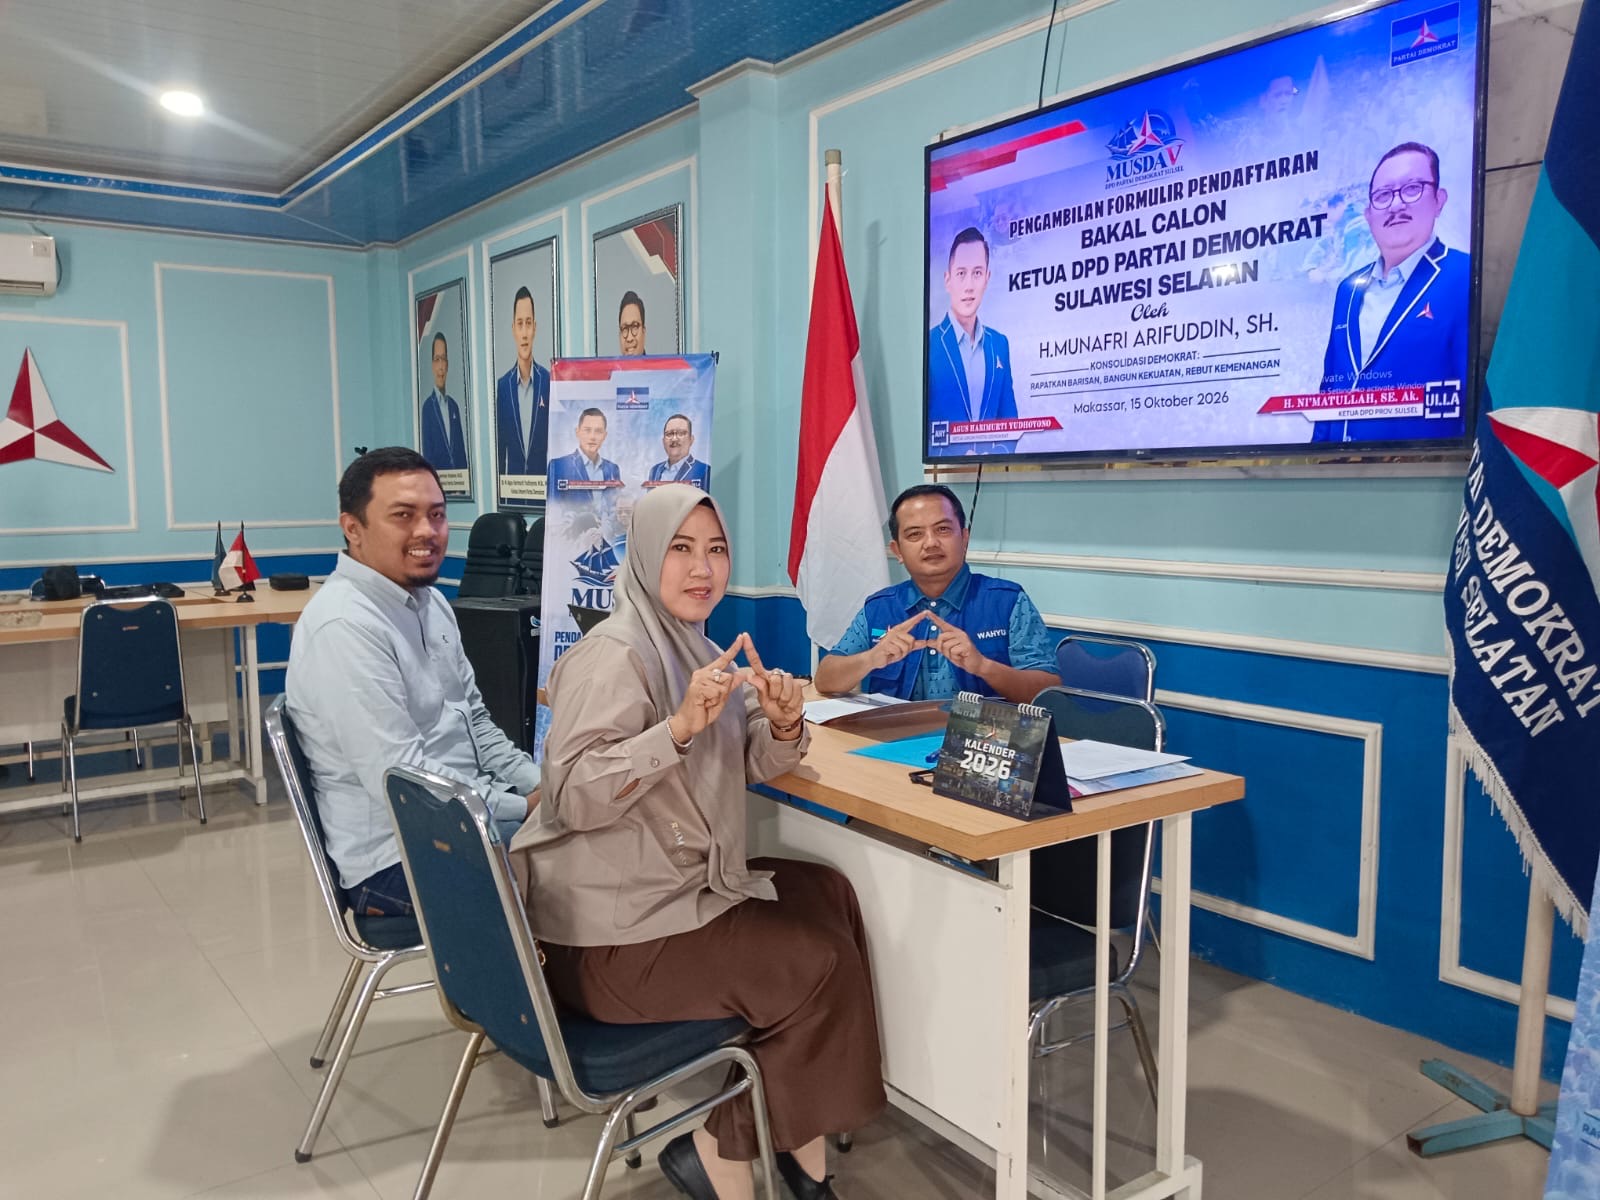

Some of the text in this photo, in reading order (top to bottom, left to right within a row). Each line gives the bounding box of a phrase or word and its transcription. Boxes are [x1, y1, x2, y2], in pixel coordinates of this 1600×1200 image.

[1393, 40, 1456, 63] PARTAI DEMOKRAT
[1106, 144, 1183, 182] MUSDA V
[1116, 178, 1134, 187] PARTAI
[1135, 170, 1164, 182] DEMOKRAT
[1009, 150, 1319, 238] PENGAMBILAN FORMULIR PENDAFTARAN
[1081, 200, 1226, 249] BAKAL CALON
[1009, 213, 1328, 292] KETUA DPD PARTAI DEMOKRAT
[1054, 260, 1258, 312] SULAWESI SELATAN
[1131, 302, 1169, 322] Oleh
[1039, 312, 1278, 359] H.MUNAFRI ARIFUDDIN, SH.
[1090, 351, 1200, 371] KONSOLIDASI DEMOKRAT:
[1030, 359, 1281, 391] RAPATKAN BARISAN, BANGUN KEKUATAN, REBUT KEMENANGAN
[1073, 391, 1229, 414] Makassar, 15 Oktober 2026
[1283, 398, 1295, 409] H.
[1380, 391, 1398, 403] SE.
[1400, 390, 1419, 402] Ak.
[1425, 392, 1460, 407] ULLA
[1338, 409, 1359, 417] KETUA
[1360, 408, 1374, 416] DPD
[1394, 406, 1418, 415] SULSEL
[952, 418, 1052, 433] AGUS HARIMURTI YUDHOYONO
[572, 588, 616, 610] MU
[554, 631, 582, 643] PENDA
[976, 628, 1007, 640] WAHYU
[1461, 575, 1565, 738] SELATAN
[964, 738, 1016, 760] KALENDER
[960, 750, 1012, 780] 2026
